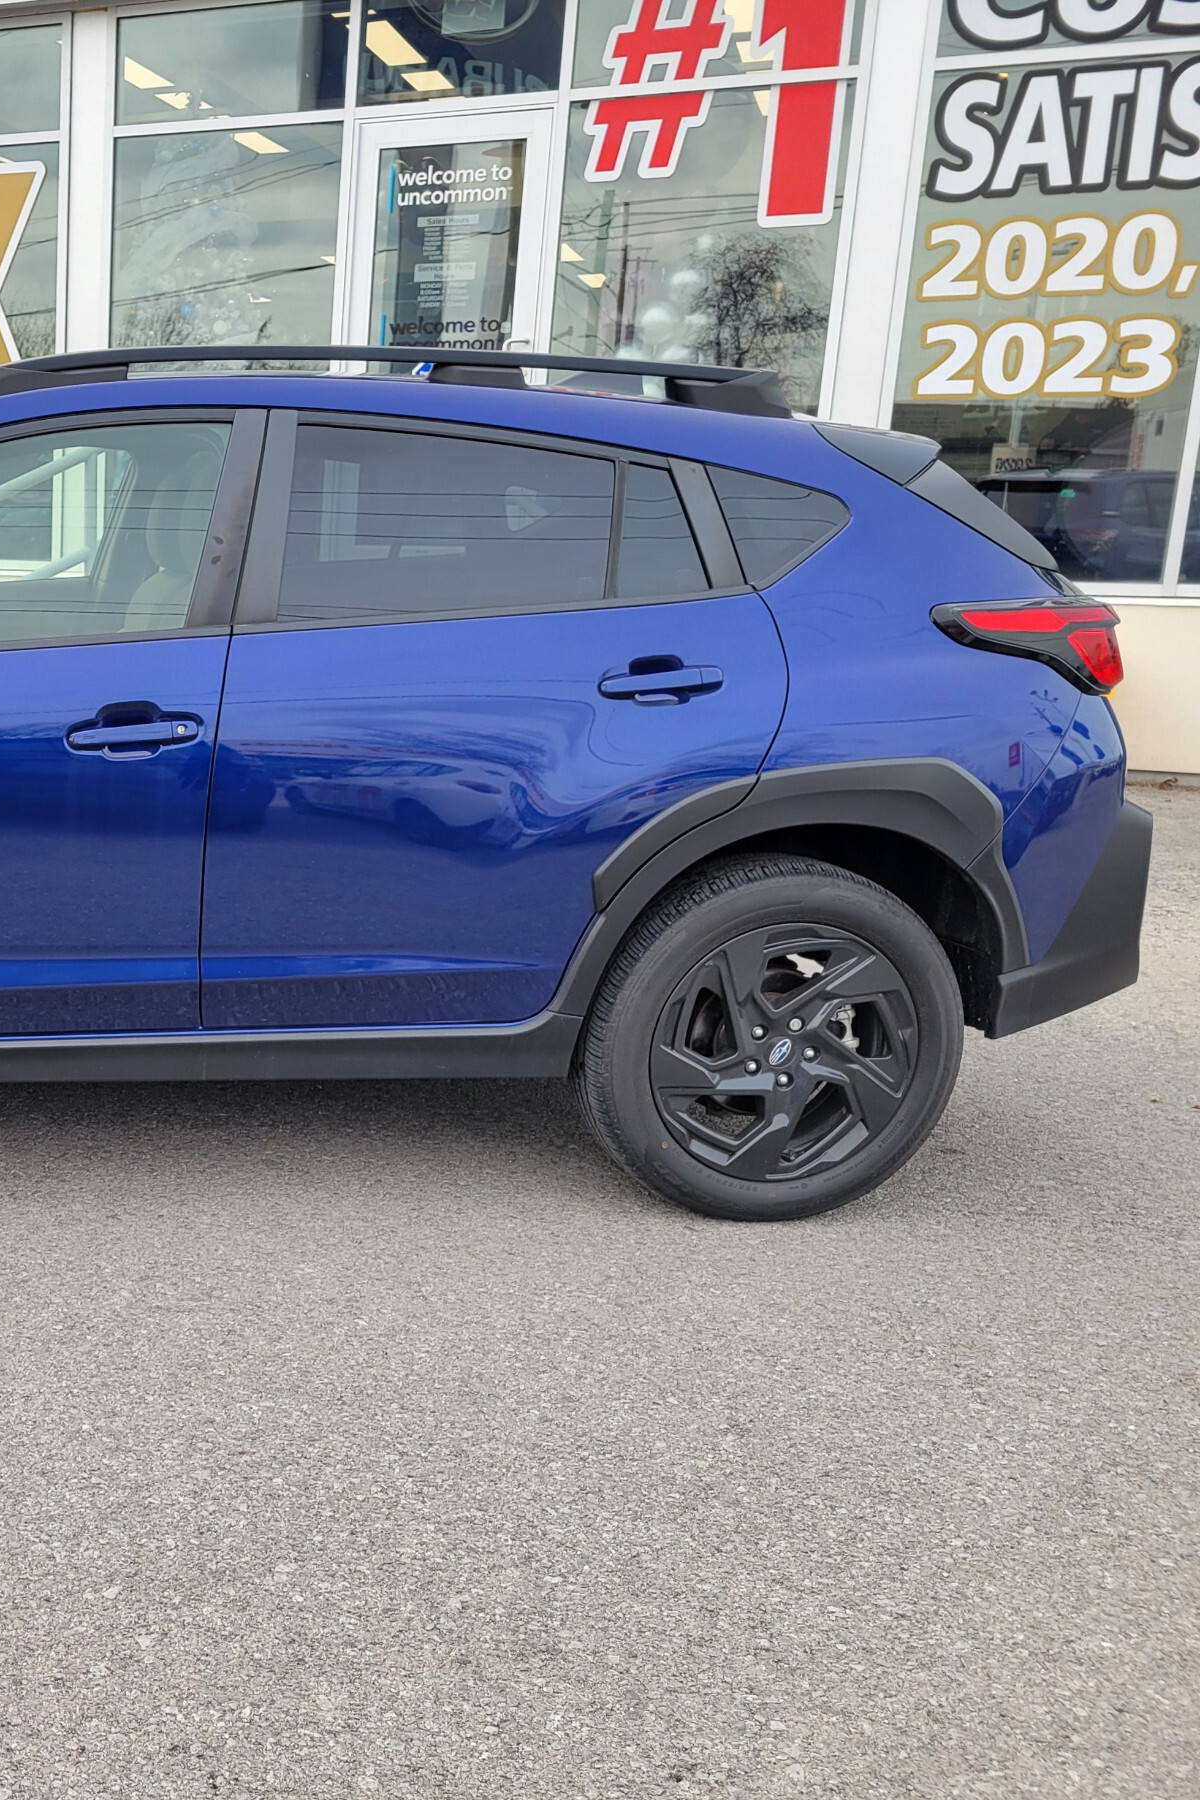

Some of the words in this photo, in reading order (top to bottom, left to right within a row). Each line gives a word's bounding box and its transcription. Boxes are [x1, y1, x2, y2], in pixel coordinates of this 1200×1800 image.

[397, 165, 486, 187] welcome
[490, 164, 513, 182] to
[916, 208, 1200, 302] 2020,
[389, 316, 476, 336] welcome
[480, 317, 500, 333] to
[910, 312, 1182, 400] 2023
